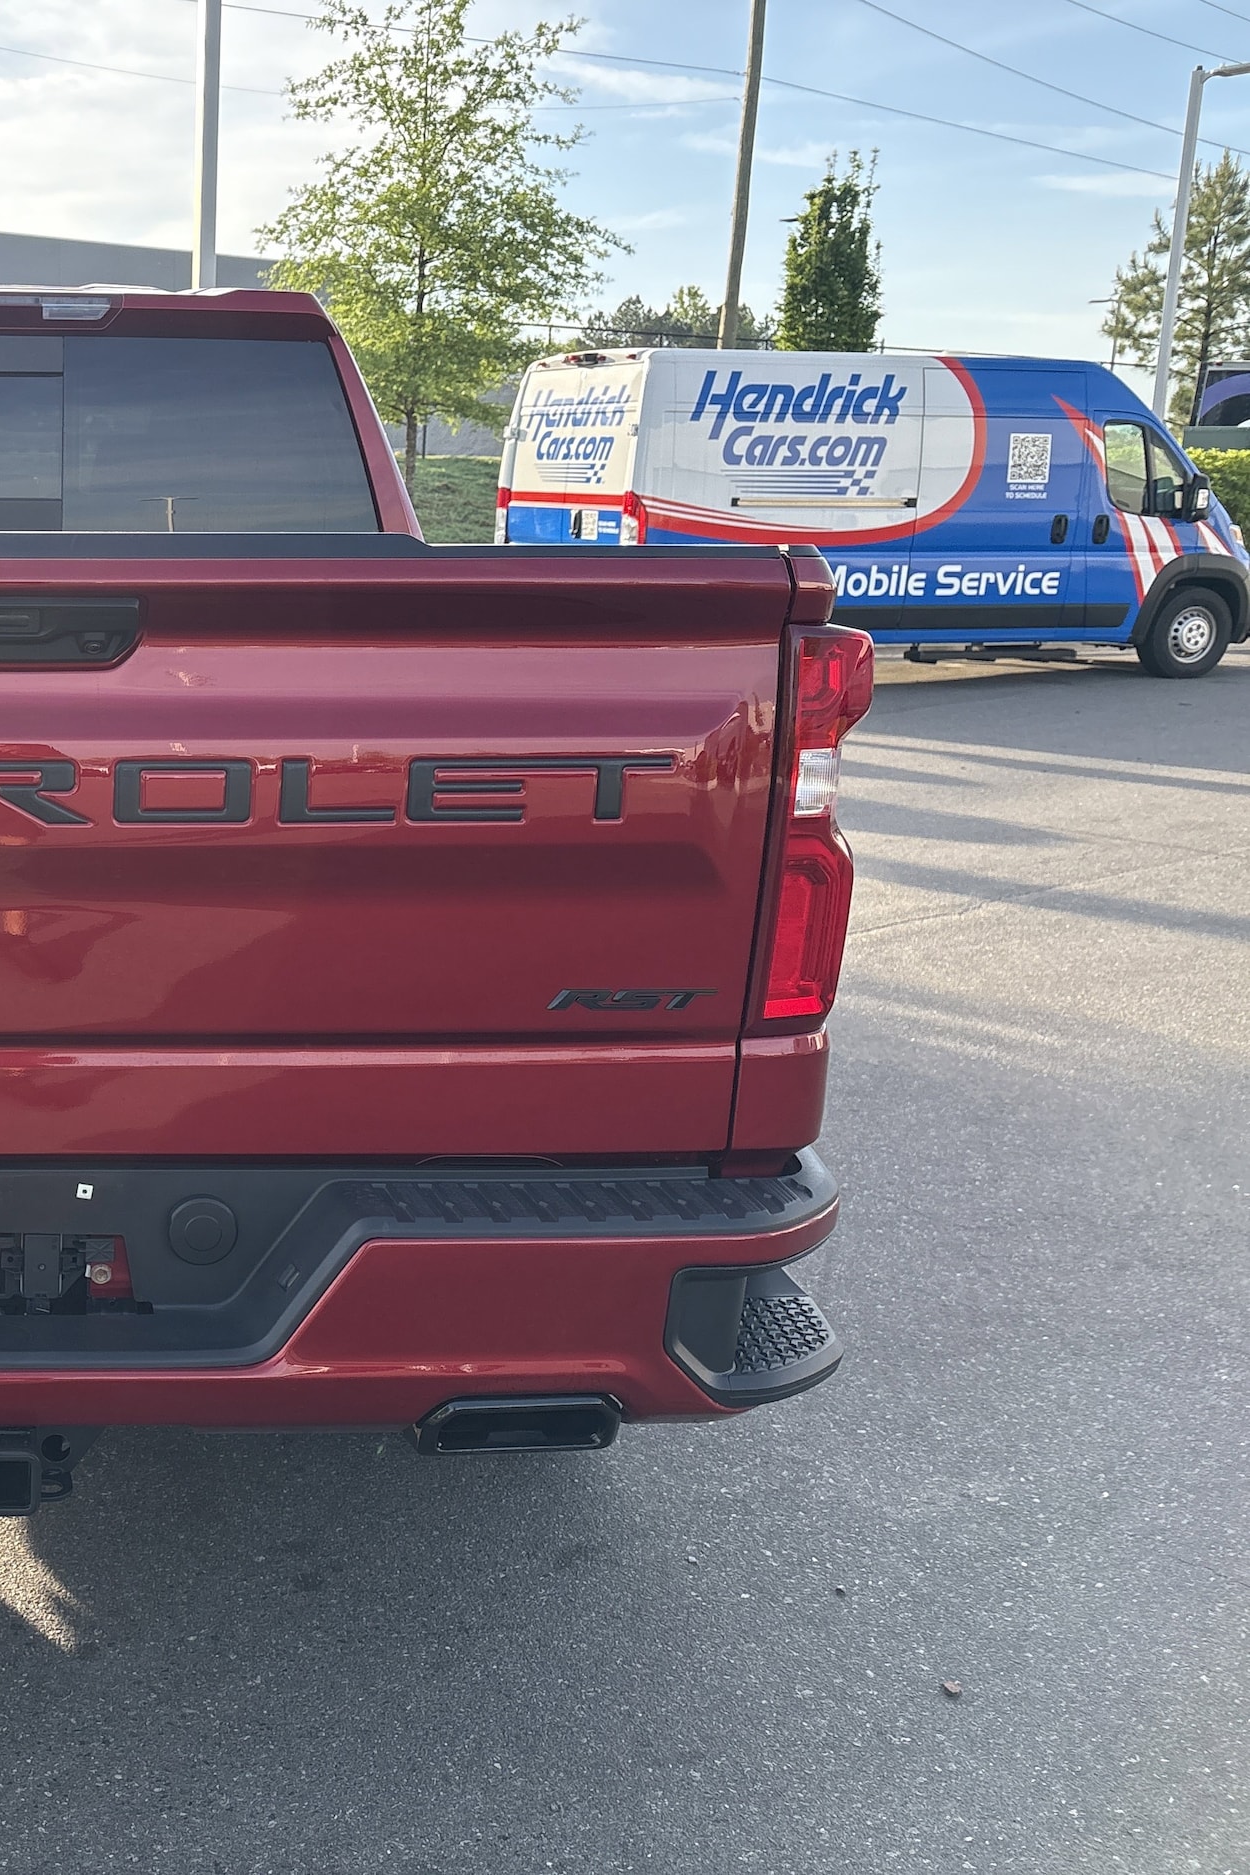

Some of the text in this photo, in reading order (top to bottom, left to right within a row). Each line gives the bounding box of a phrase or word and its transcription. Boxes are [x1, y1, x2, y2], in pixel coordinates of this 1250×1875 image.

[526, 384, 631, 441] Hendrick
[690, 370, 908, 440] Hendrick
[536, 431, 615, 461] Cars.com
[722, 425, 888, 467] Cars.com
[935, 564, 1061, 597] Service
[546, 988, 718, 1011] RST
